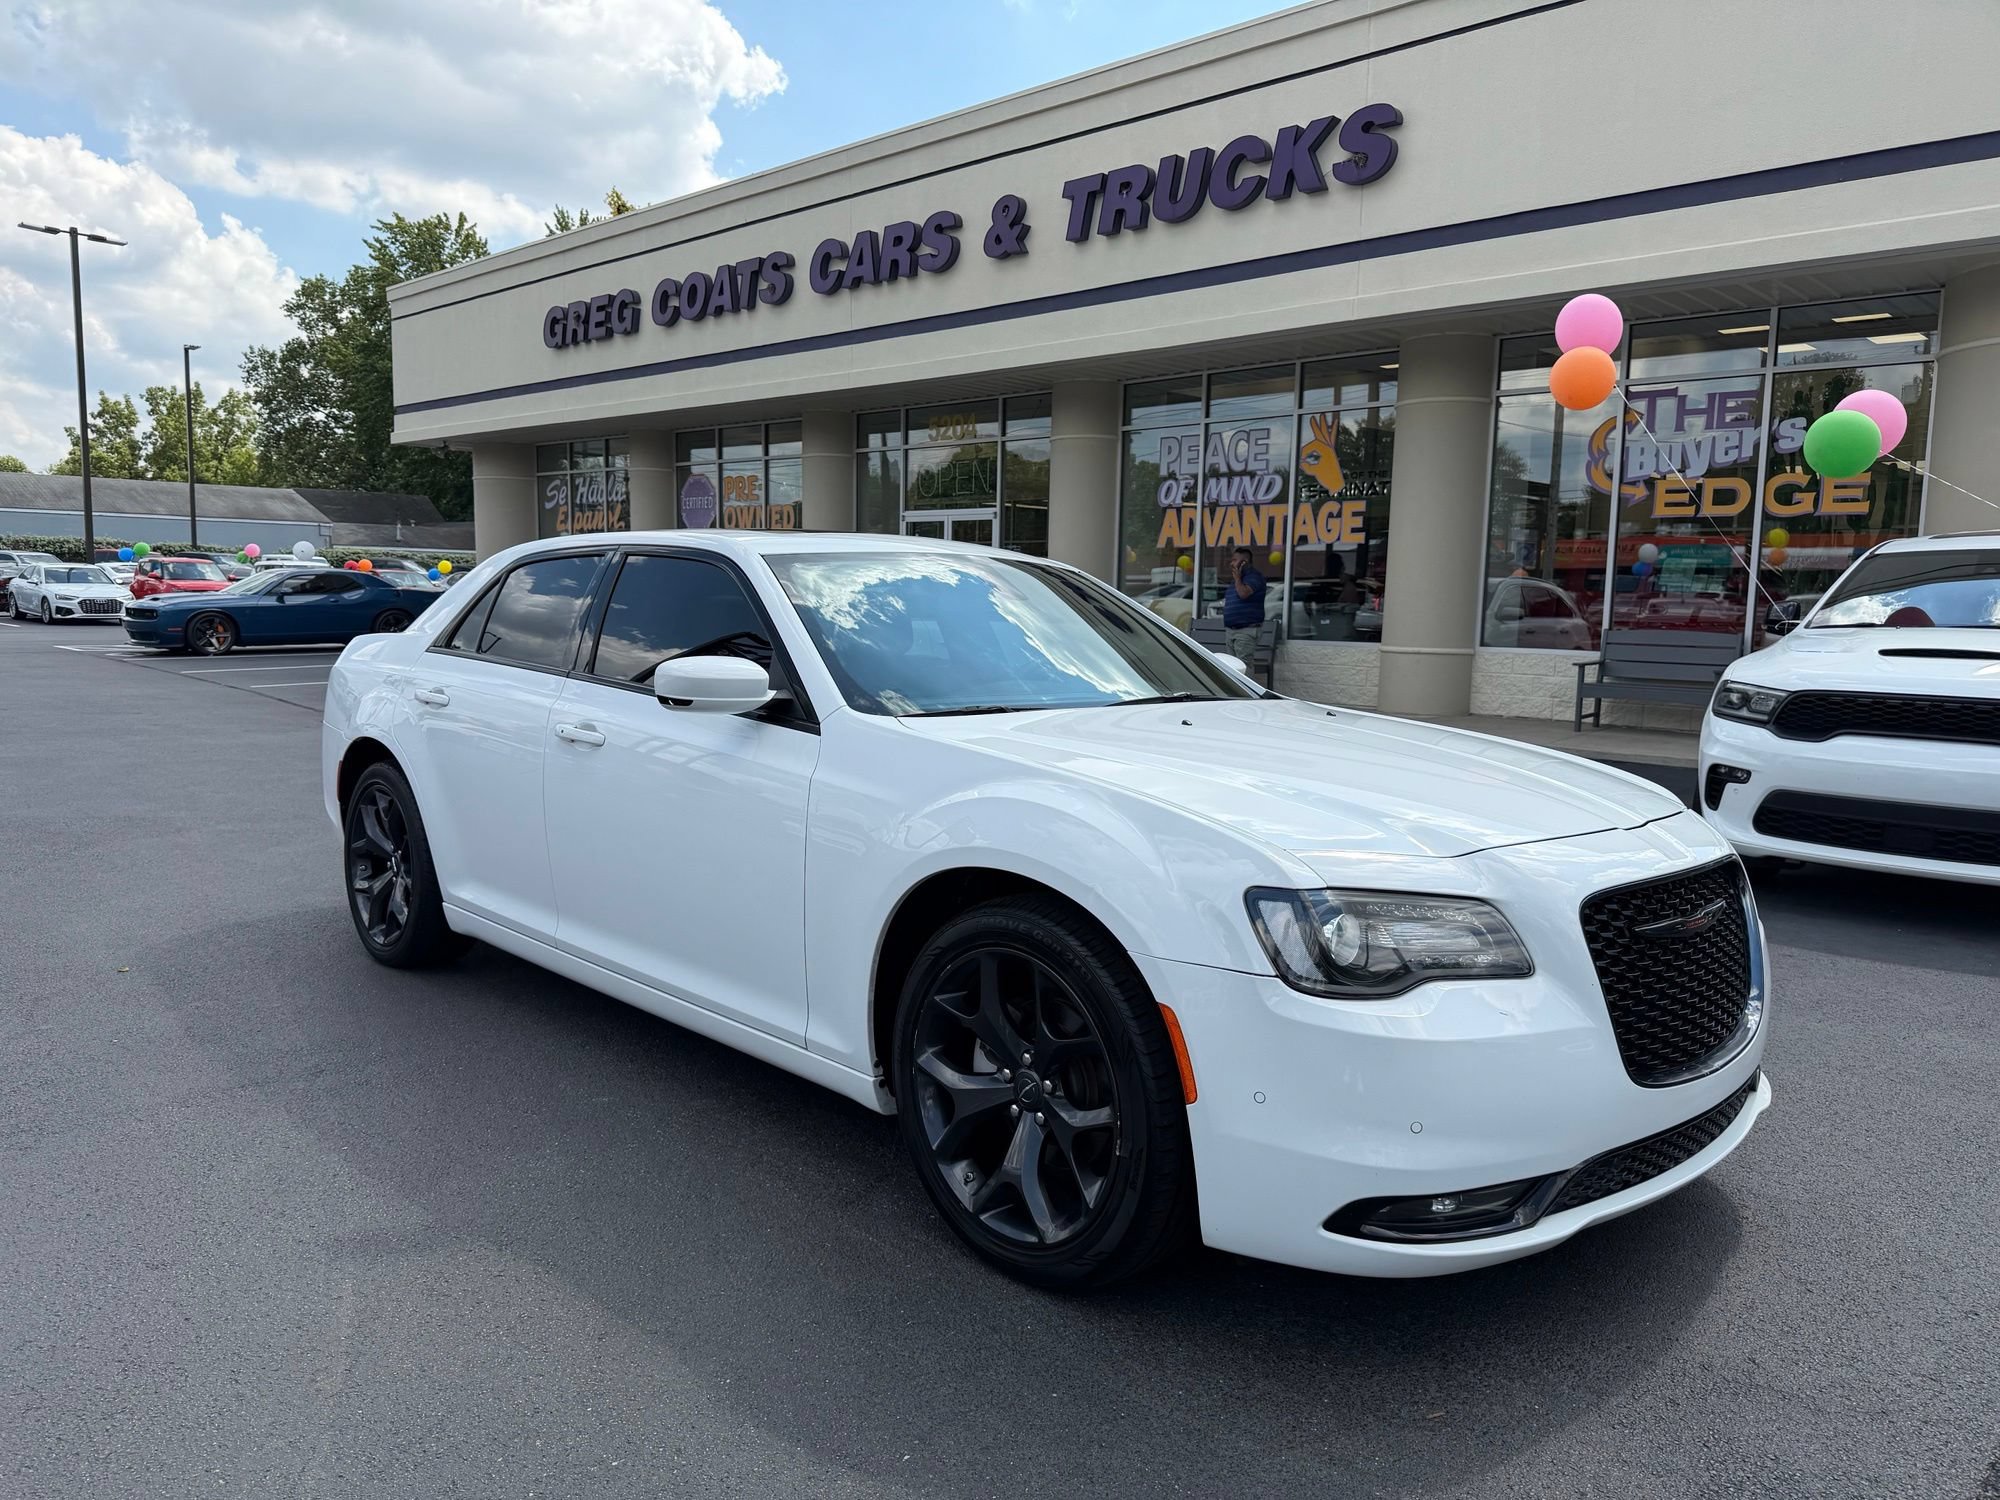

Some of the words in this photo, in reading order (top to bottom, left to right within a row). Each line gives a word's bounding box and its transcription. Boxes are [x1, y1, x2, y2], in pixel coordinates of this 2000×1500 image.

[543, 288, 641, 349] GREG
[651, 250, 795, 328] COATS
[809, 210, 963, 296] CARS
[983, 193, 1032, 261] &
[1061, 102, 1404, 244] TRUCKS
[928, 413, 977, 442] 5204
[1628, 385, 1758, 434] THE
[1159, 428, 1270, 477] PEACE
[1624, 415, 1807, 480] Buyer's
[544, 479, 567, 509] Se
[918, 458, 992, 497] OPEN
[1157, 477, 1195, 507] OF
[1203, 473, 1284, 505] MIND
[1652, 471, 1872, 518] EDGE
[682, 496, 713, 510] CERTIFIED
[724, 503, 795, 528] OWNED
[1157, 500, 1367, 549] ADVANTAGE
